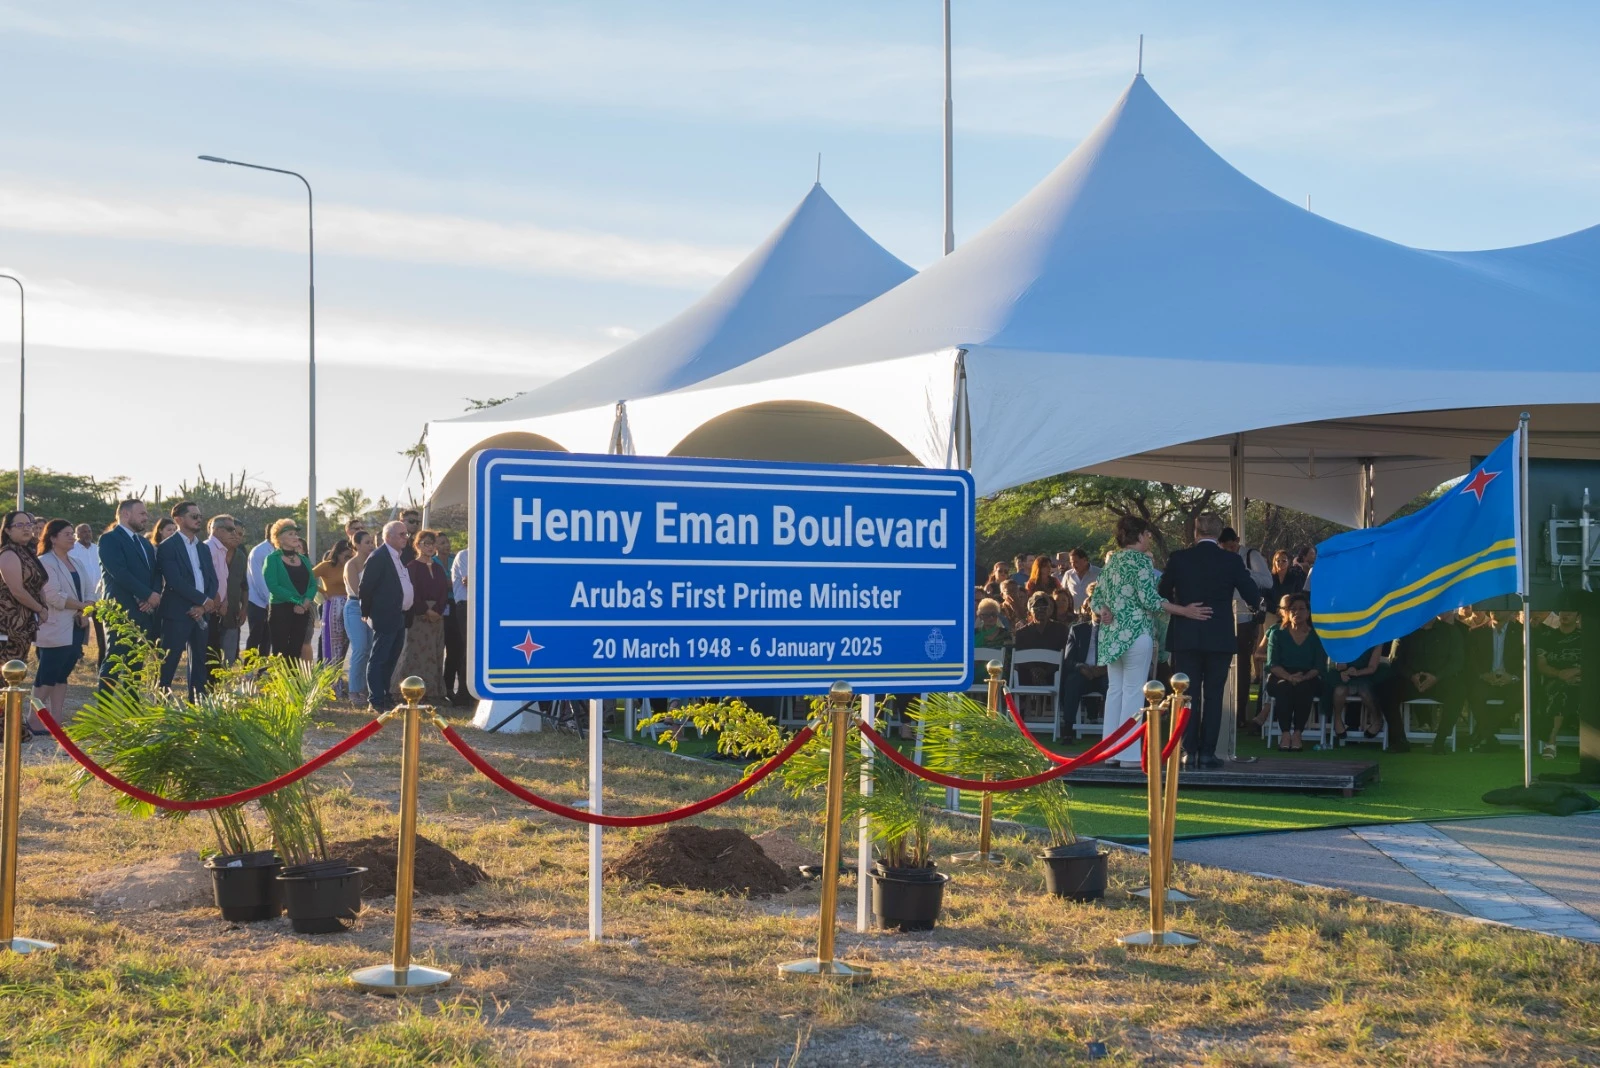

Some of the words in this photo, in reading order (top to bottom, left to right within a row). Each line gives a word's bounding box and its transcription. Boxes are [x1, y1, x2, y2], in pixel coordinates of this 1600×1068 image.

[513, 497, 642, 555] Henny
[655, 501, 759, 545] Eman
[773, 505, 947, 549] Boulevard
[570, 580, 663, 609] Aruba’s
[671, 581, 726, 609] First
[733, 582, 803, 609] Prime
[810, 582, 902, 609] Minister
[592, 638, 617, 659] 20
[622, 637, 680, 659] March
[687, 637, 731, 658] 1948
[750, 637, 761, 658] 6
[766, 637, 836, 662] January
[840, 636, 882, 657] 2025
